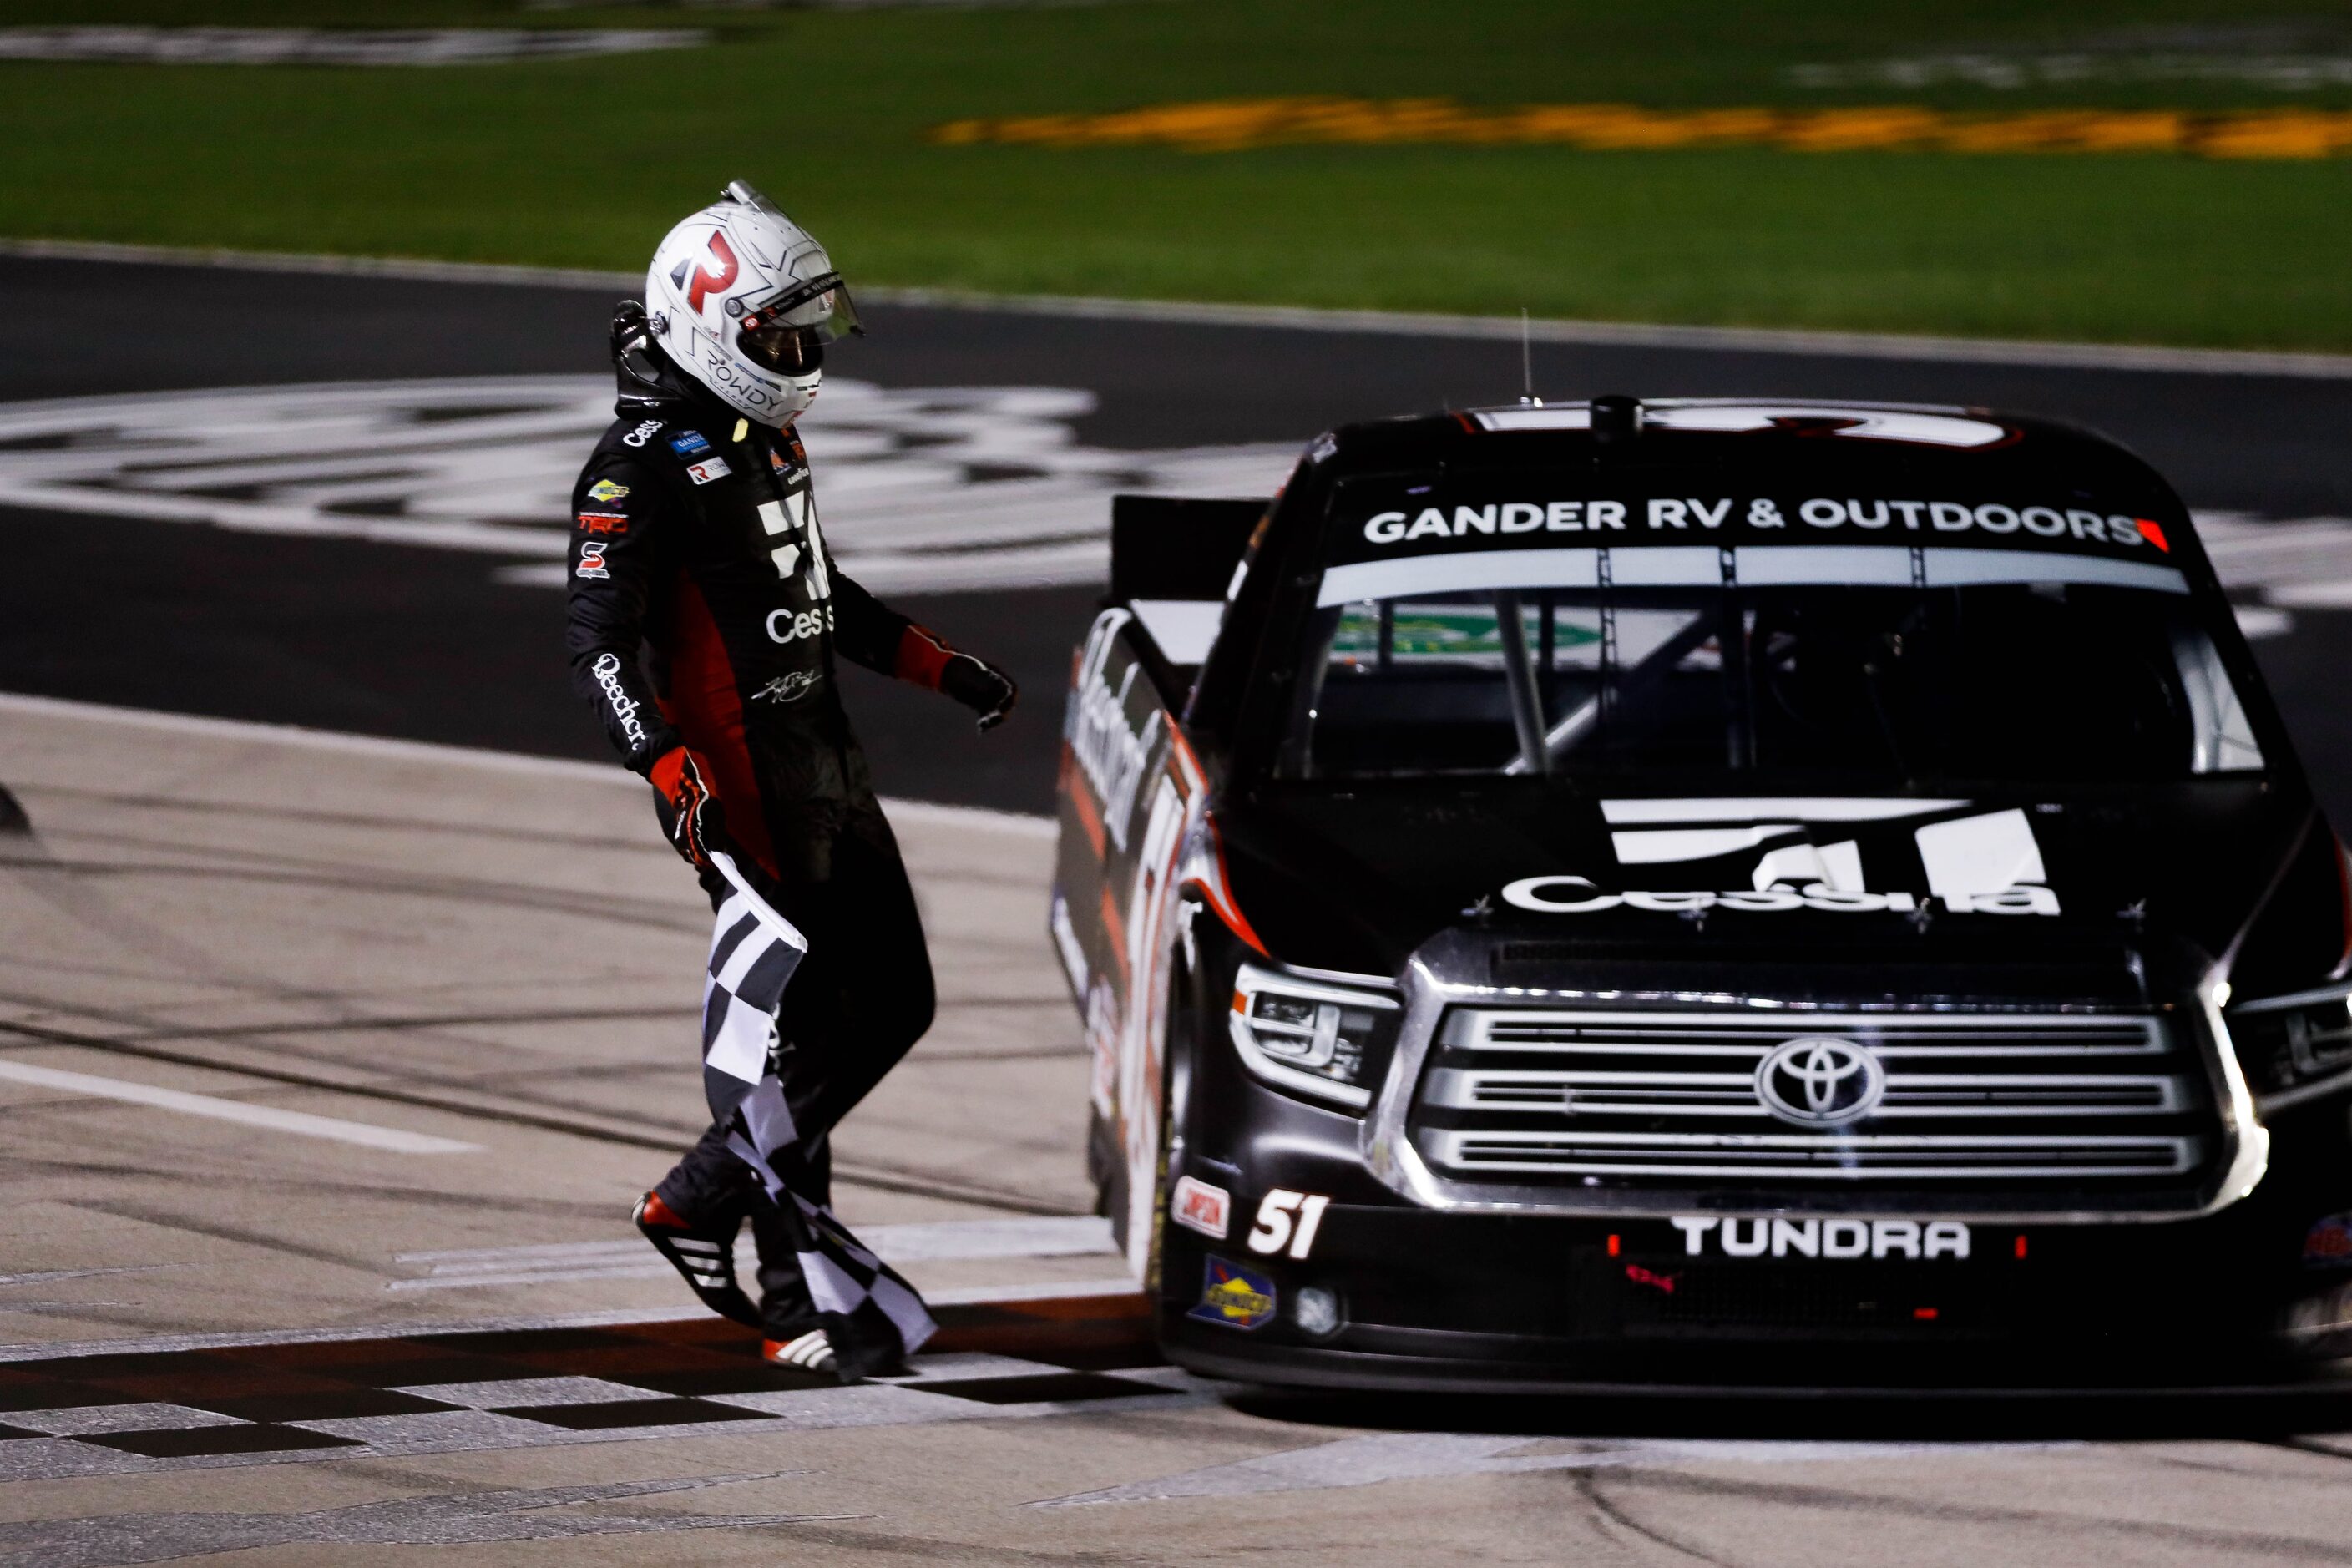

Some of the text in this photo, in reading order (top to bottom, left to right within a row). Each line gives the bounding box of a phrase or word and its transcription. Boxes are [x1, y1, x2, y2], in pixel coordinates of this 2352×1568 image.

[707, 349, 783, 411] ROWDY
[1363, 499, 2145, 546] GANDER RV & OUTDOORS
[591, 653, 647, 751] Beechcr
[1247, 1188, 1331, 1259] 51
[1671, 1216, 1971, 1259] TUNDRA
